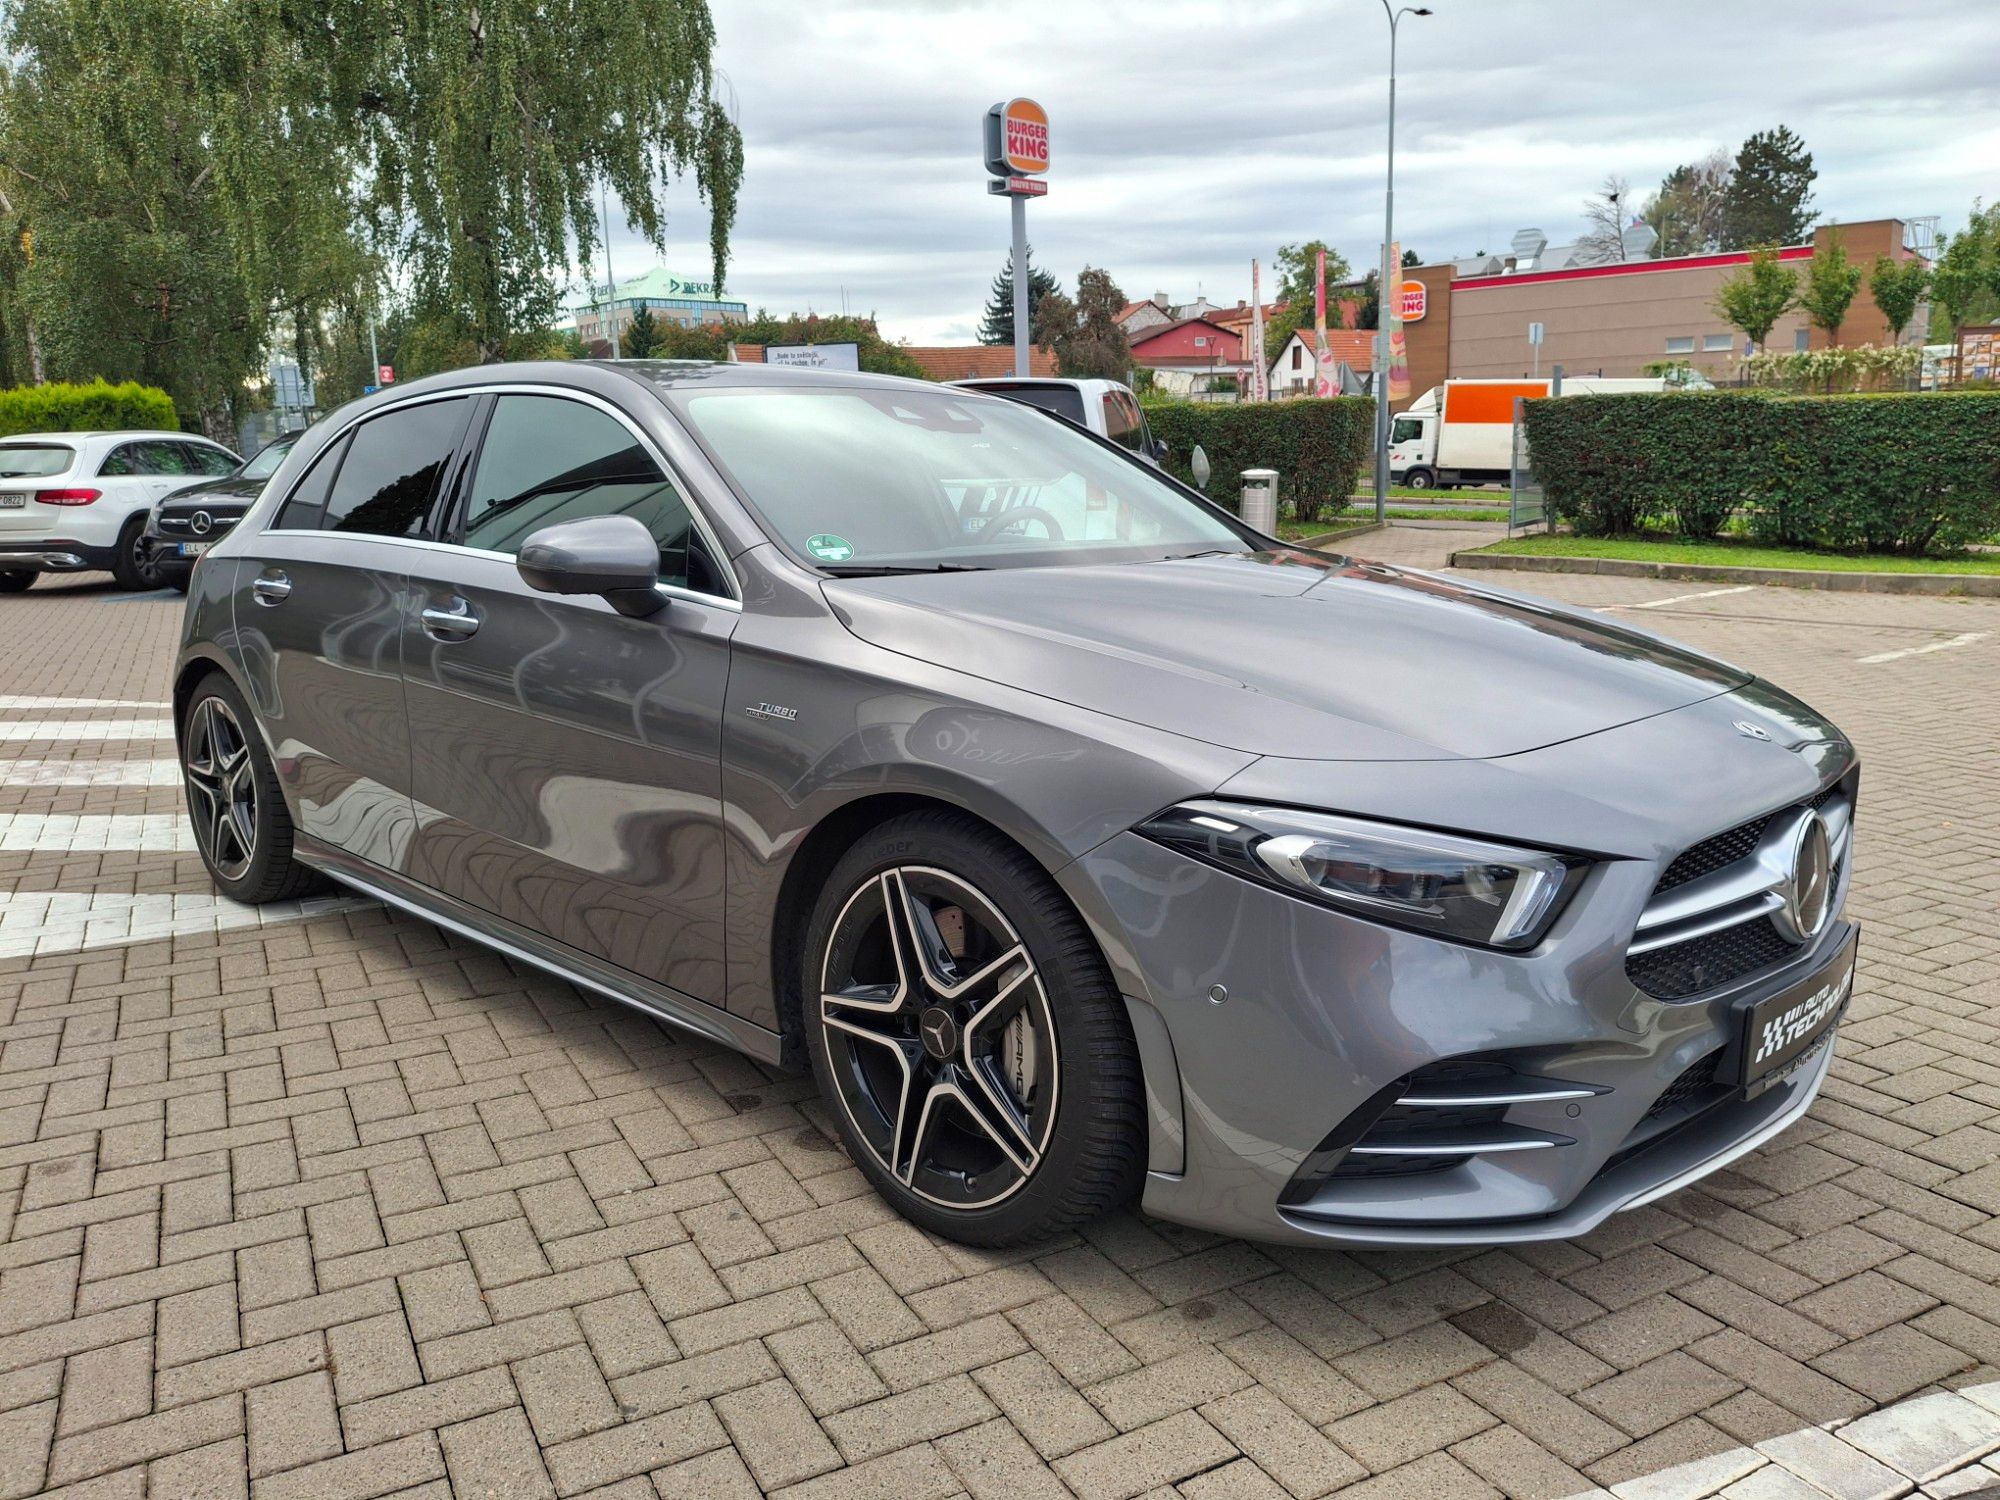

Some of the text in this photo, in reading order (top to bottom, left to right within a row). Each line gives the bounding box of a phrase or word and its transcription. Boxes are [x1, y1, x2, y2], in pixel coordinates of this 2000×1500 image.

[1007, 119, 1047, 140] BURGER
[1007, 135, 1048, 160] KING
[597, 284, 616, 296] DEKA
[1402, 293, 1424, 301] RGER
[1402, 301, 1424, 312] ING
[3, 496, 21, 504] 0822
[758, 702, 798, 718] TURBO
[1803, 983, 1831, 1014] AUTO
[1016, 1036, 1024, 1096] AMG
